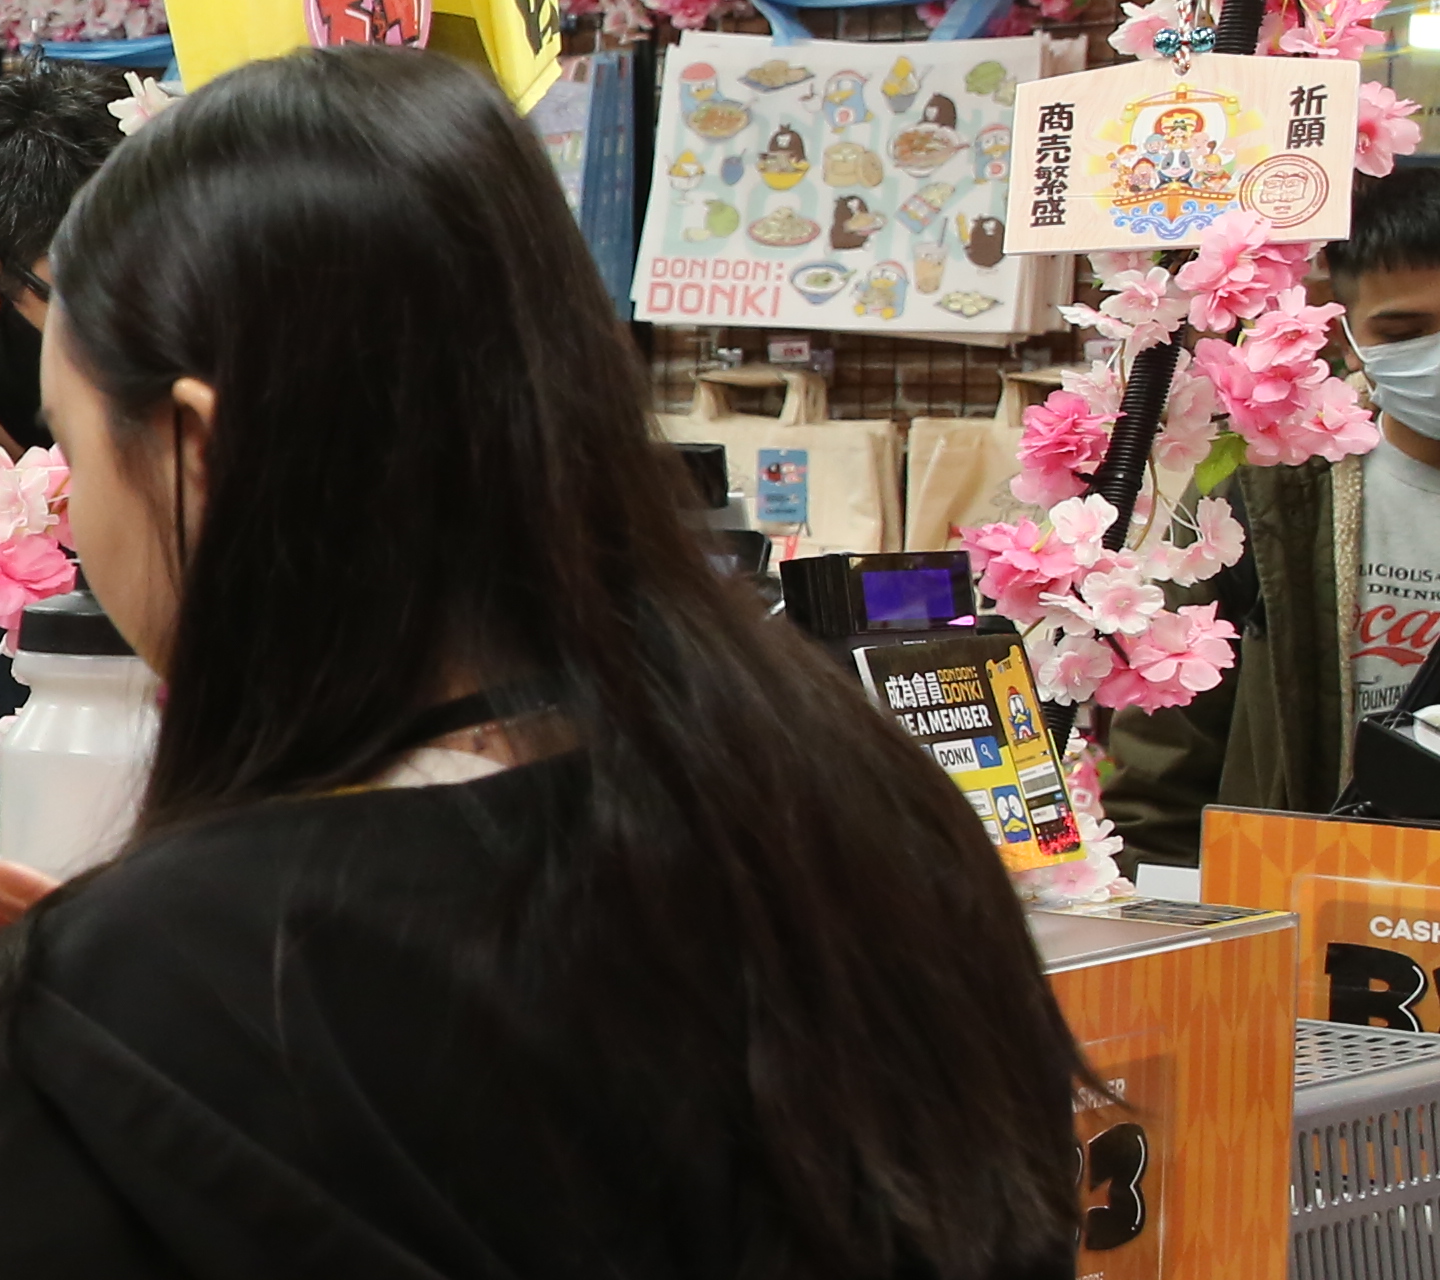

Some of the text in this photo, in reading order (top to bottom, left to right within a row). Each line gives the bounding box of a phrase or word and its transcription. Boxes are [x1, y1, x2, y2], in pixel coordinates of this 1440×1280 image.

[1286, 84, 1329, 151] 祈願
[1030, 101, 1077, 229] 商売繁盛
[646, 284, 783, 319] DONKI
[1358, 562, 1432, 583] LICIOUS
[884, 671, 945, 710] 成為會員
[930, 703, 993, 734] MEMBER
[939, 744, 975, 767] DONKI
[1369, 914, 1440, 945] CASH
